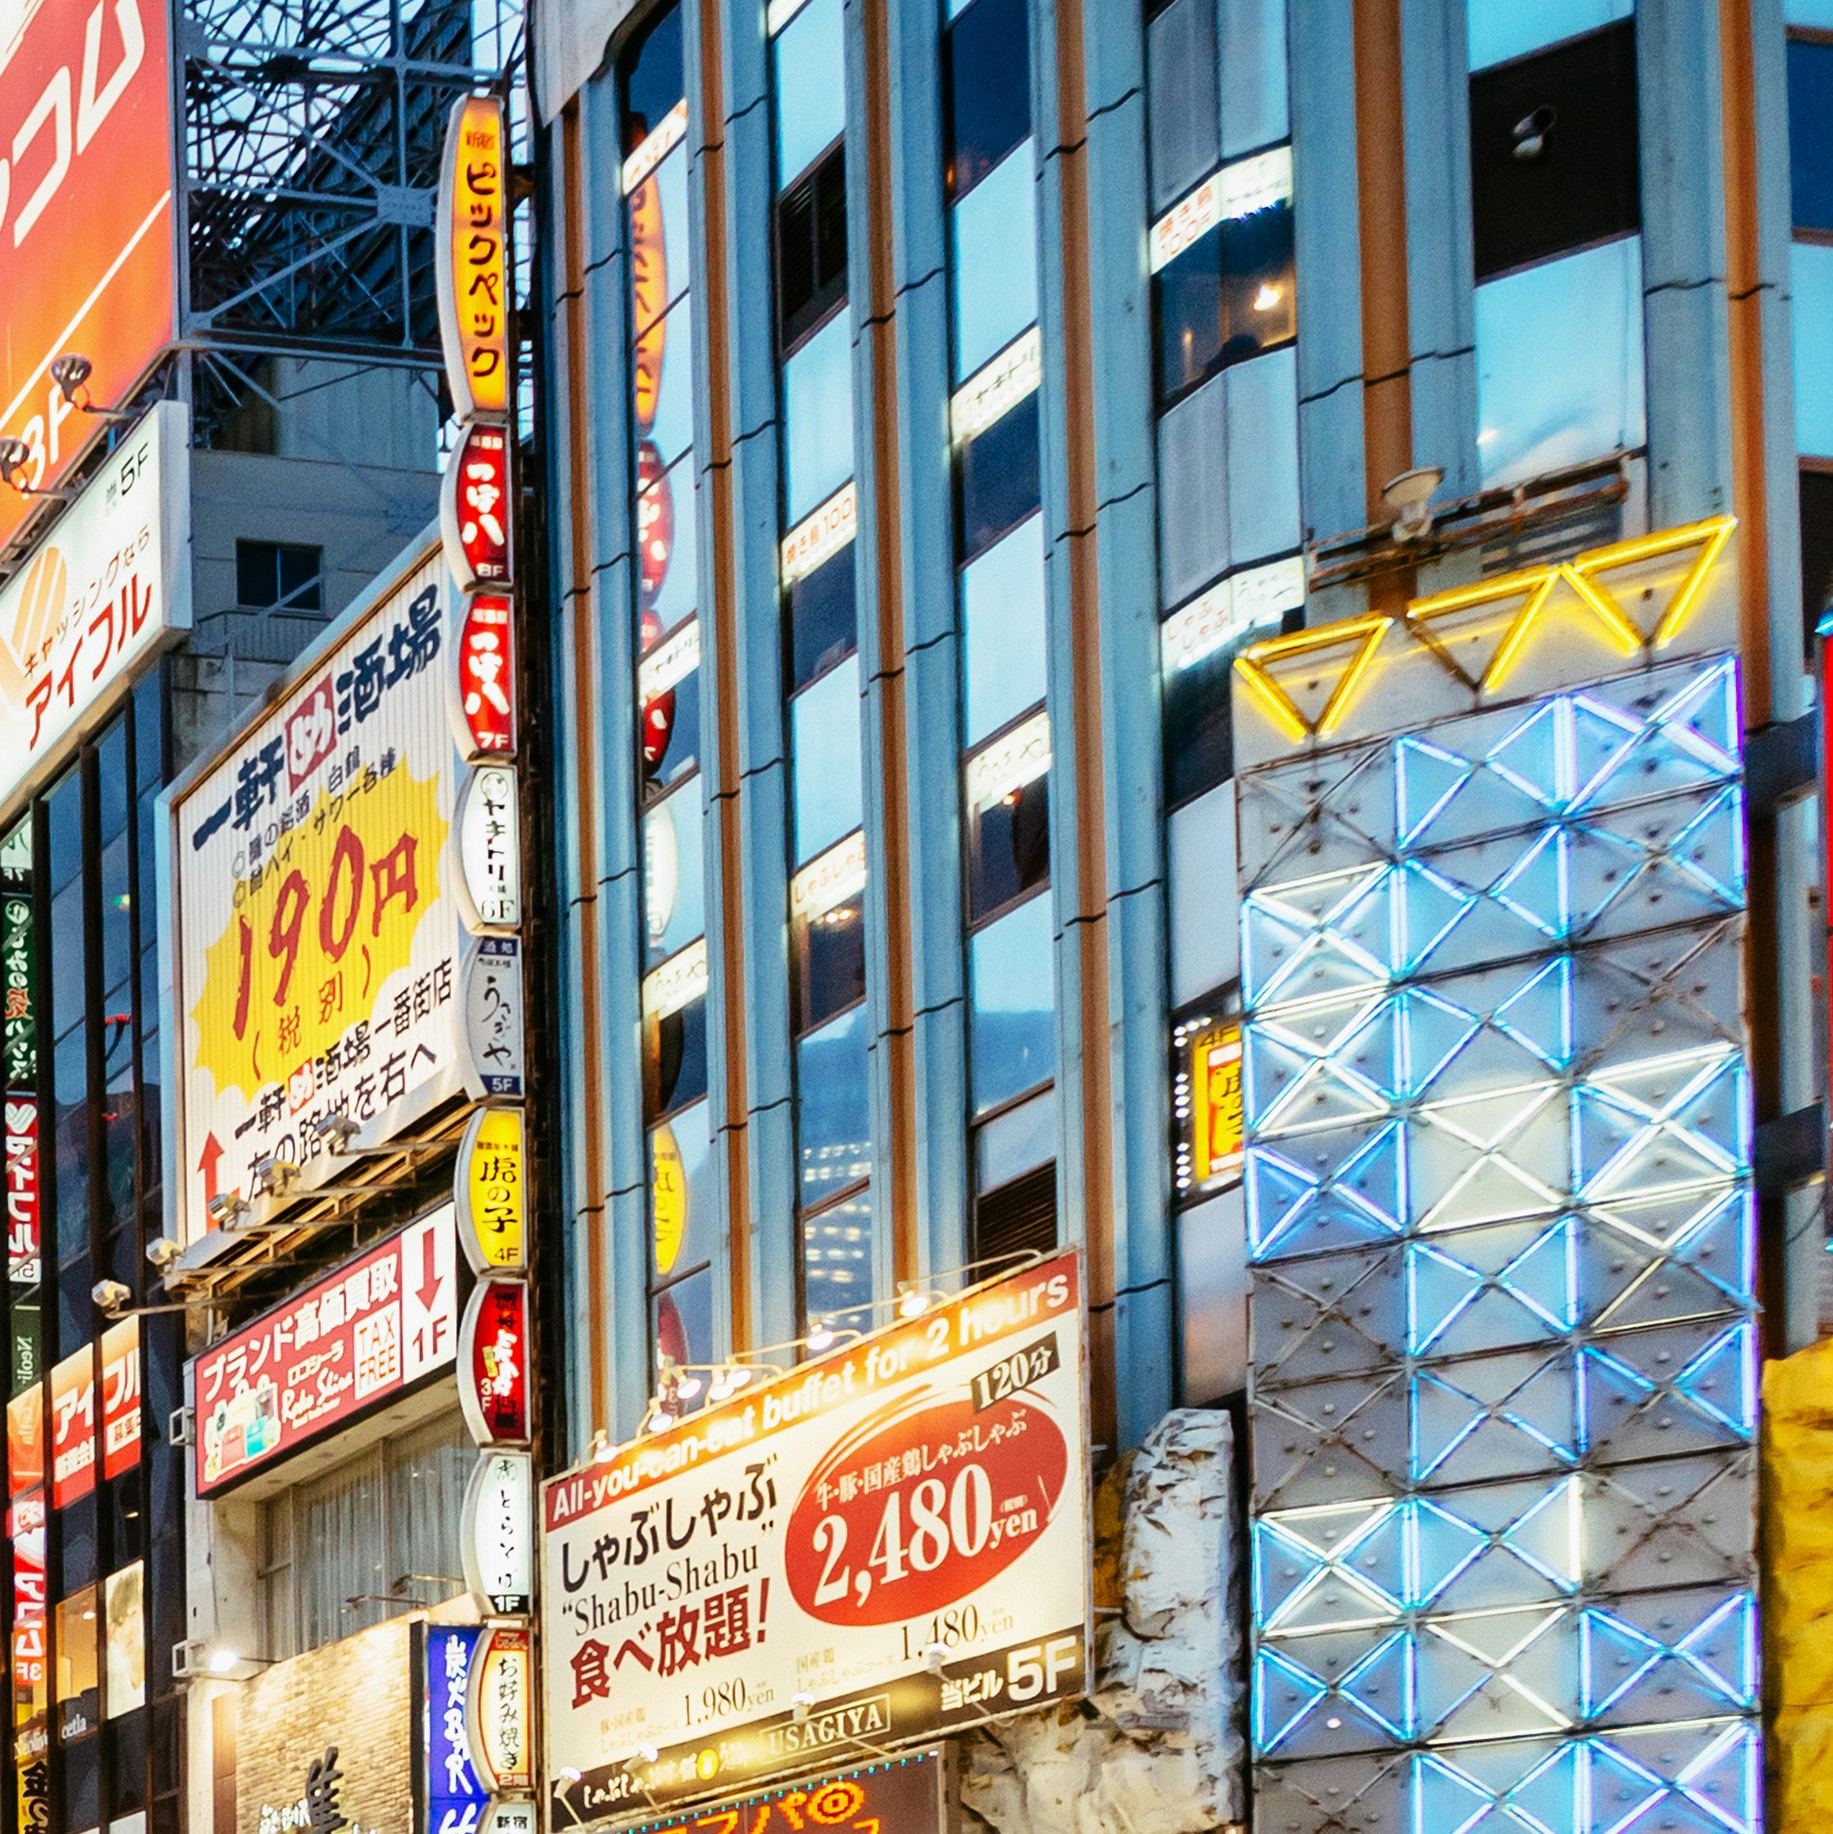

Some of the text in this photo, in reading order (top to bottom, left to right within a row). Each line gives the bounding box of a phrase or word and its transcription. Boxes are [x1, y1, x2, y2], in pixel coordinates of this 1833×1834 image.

[119, 439, 151, 501] 5F
[22, 525, 152, 681] キャッシングなら
[25, 575, 154, 752] アイフル
[190, 582, 440, 854] 一軒め酒場
[475, 731, 510, 749] 7F
[232, 823, 420, 1042] 190円
[479, 898, 513, 921] 6F
[233, 956, 454, 1139] 一軒め酒場 一番街店
[491, 1075, 513, 1093] 5F
[479, 1155, 520, 1233] 虎の子
[493, 1246, 519, 1262] 4F
[202, 1254, 399, 1400] ブランド高価買取
[357, 1313, 396, 1351] TAX
[412, 1317, 449, 1366] 1F
[762, 1367, 856, 1440] buffet
[865, 1335, 916, 1388] for
[924, 1323, 950, 1359] 2
[960, 1271, 1070, 1344] hours
[356, 1346, 398, 1392] FREE
[978, 1349, 1054, 1410] 120分
[562, 1452, 780, 1594] しゃぶしゃぶ
[811, 1460, 1039, 1609] 2,480 yen
[493, 1594, 520, 1613] 1F
[1007, 1636, 1079, 1700] 5F
[497, 1655, 522, 1771] お好み焼き
[767, 1702, 885, 1756] USAGIYA
[495, 1813, 528, 1831] 新宿
